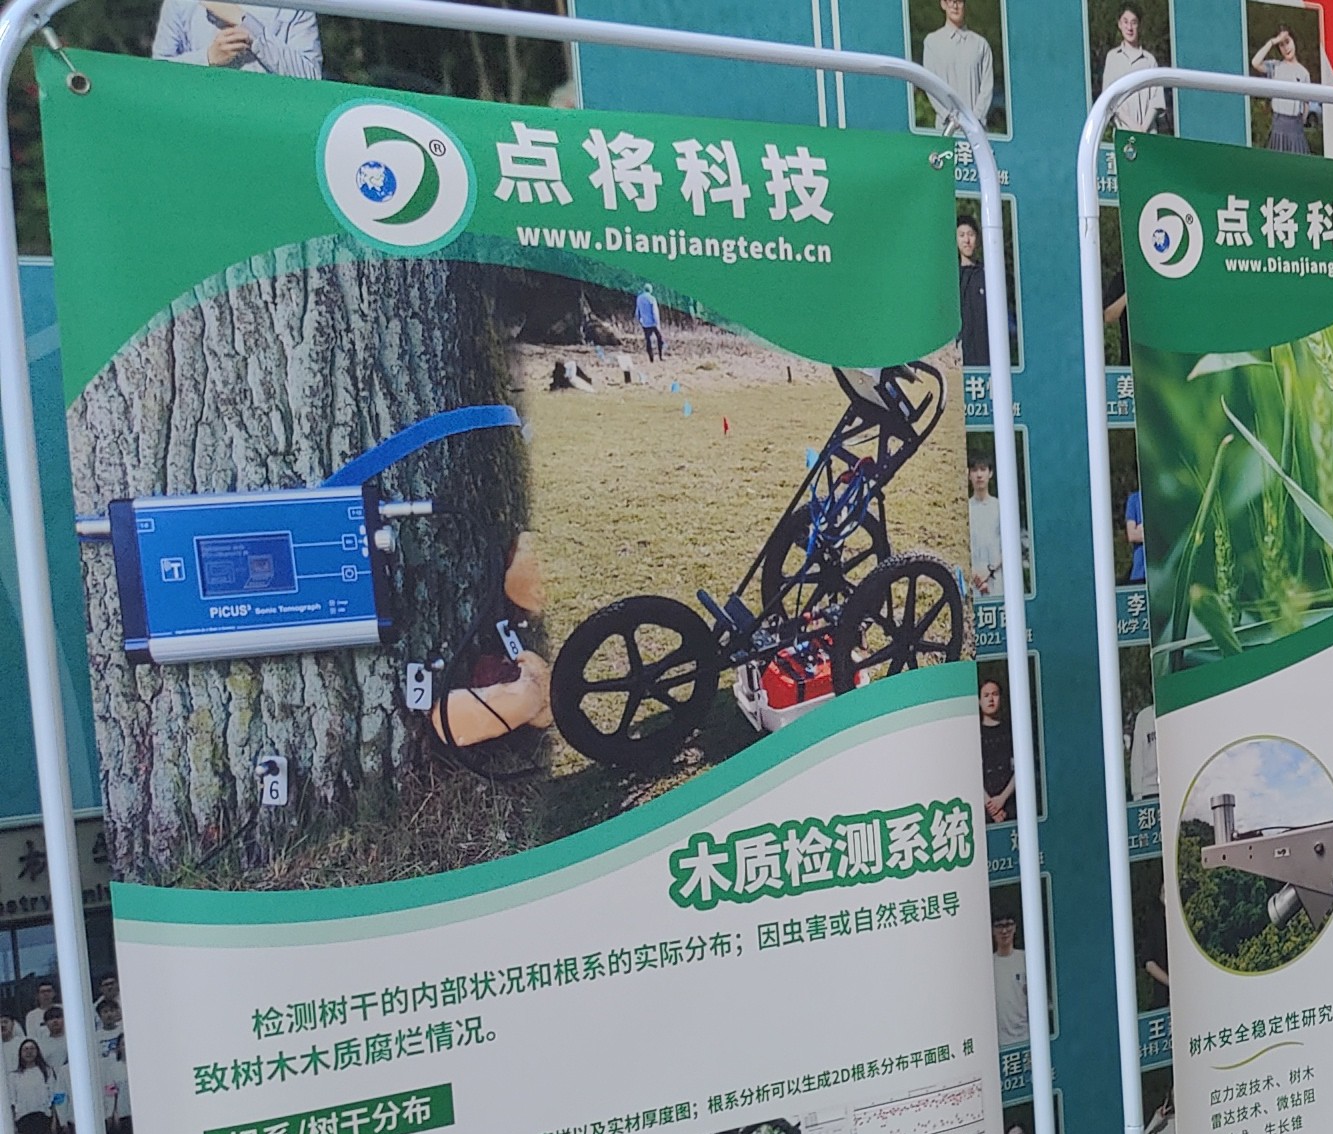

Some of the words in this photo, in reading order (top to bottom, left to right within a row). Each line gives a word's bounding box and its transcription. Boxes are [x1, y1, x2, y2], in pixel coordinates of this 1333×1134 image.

[494, 121, 835, 224] 点将科技
[517, 223, 832, 266] www.Dianjiangtech.cn
[966, 376, 993, 401] 书
[1131, 595, 1146, 617] 李
[413, 687, 425, 704] 7
[268, 780, 280, 800] 6
[677, 806, 974, 904] 木质检测系统
[251, 891, 962, 1040] 检测树干的内部状况和根系的实际分布；因虫害或自然衰退导
[1189, 1003, 1333, 1057] 树木安全稳定性研究
[193, 1015, 500, 1097] 致树木木质腐烂情况。
[1209, 1066, 1316, 1107] 应力波技术、树木
